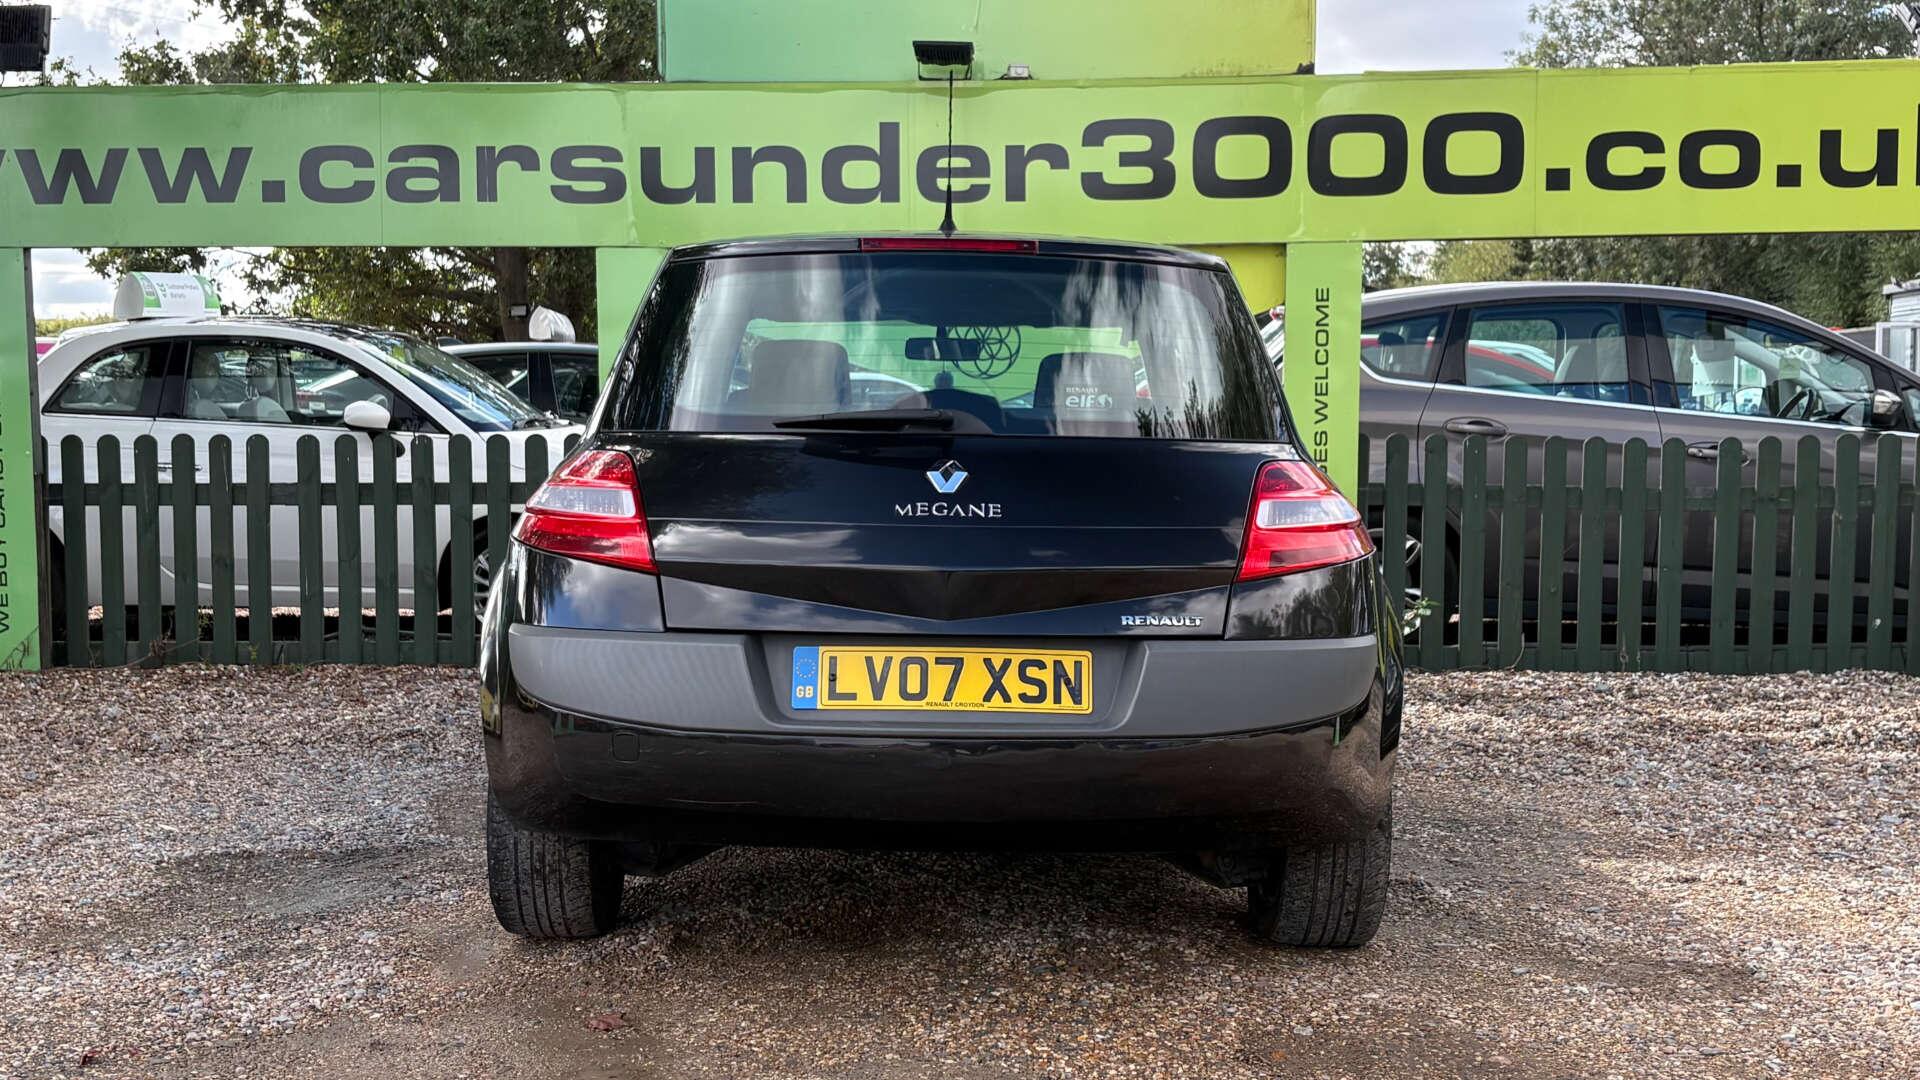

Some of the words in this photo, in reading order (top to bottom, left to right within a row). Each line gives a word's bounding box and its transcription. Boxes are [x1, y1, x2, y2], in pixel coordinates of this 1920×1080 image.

[0, 103, 1920, 206] ww.carsunder3000.co.u
[1314, 287, 1330, 425] WELCOME
[1065, 394, 1096, 408] elf
[895, 502, 1002, 518] MEGANE
[1120, 615, 1204, 626] RENAULT
[827, 655, 965, 702] LV07
[982, 657, 1083, 706] XSN
[796, 686, 814, 698] GB
